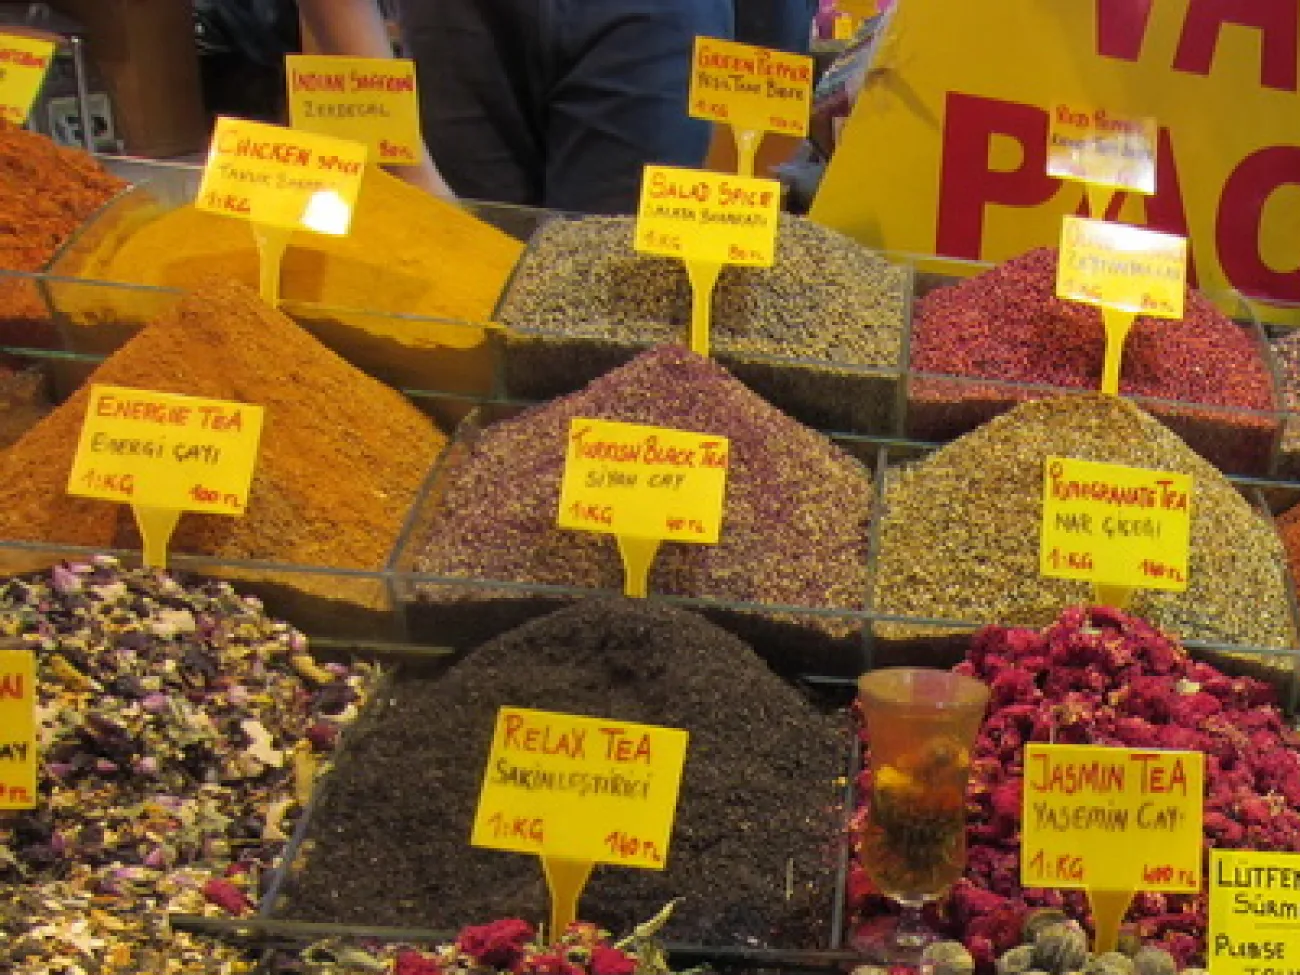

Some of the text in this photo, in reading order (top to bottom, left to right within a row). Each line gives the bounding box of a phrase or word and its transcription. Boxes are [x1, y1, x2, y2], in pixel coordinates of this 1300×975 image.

[651, 171, 710, 202] SALAD
[97, 396, 243, 432] ENERGIE TEA
[503, 714, 652, 765] RELAX TEA
[1030, 754, 1187, 797] JASMIN TEA
[1214, 933, 1285, 960] PLEASE
